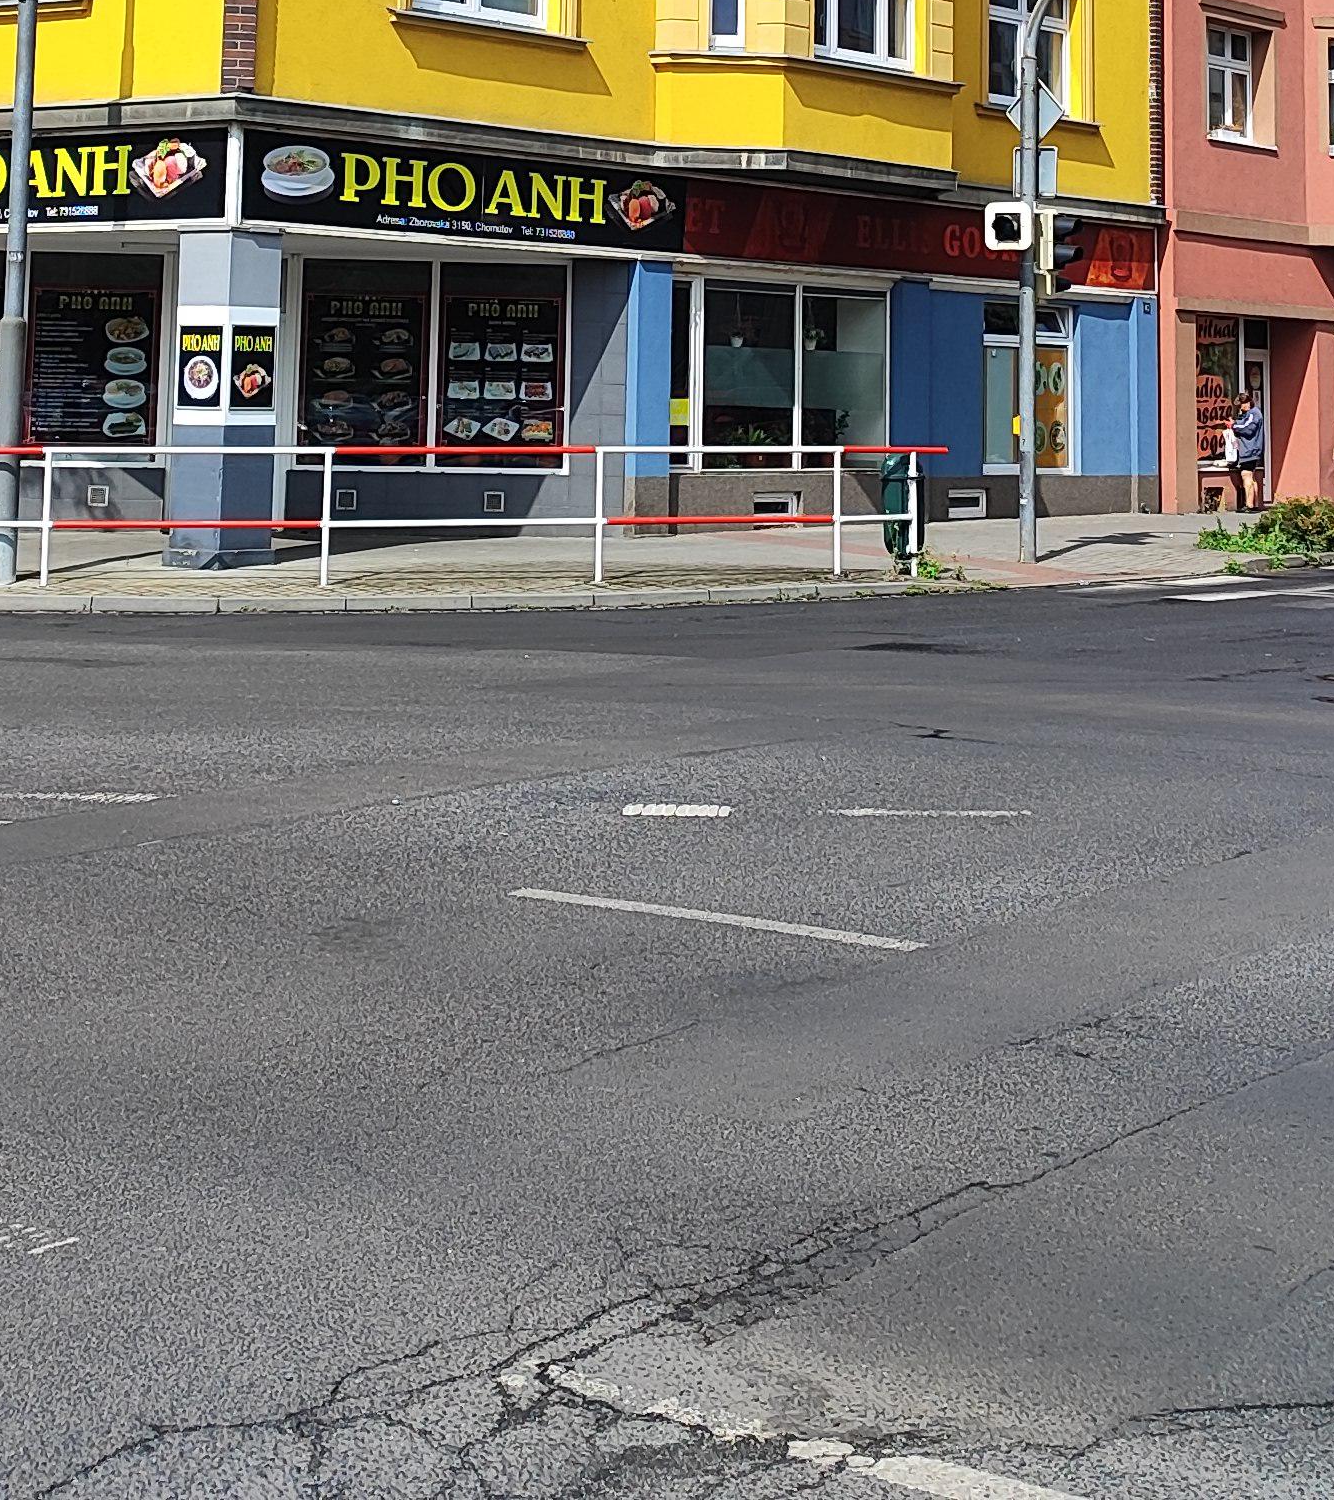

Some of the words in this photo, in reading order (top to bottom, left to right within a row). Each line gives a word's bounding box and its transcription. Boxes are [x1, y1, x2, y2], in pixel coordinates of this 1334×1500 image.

[28, 145, 132, 199] ANH
[339, 152, 476, 212] PHO
[484, 169, 607, 224] ANH
[58, 295, 93, 310] PHO
[330, 300, 363, 316] PHO
[181, 333, 202, 352] PHO
[201, 333, 221, 352] ANH
[234, 335, 254, 352] PHO
[254, 336, 273, 353] ANH
